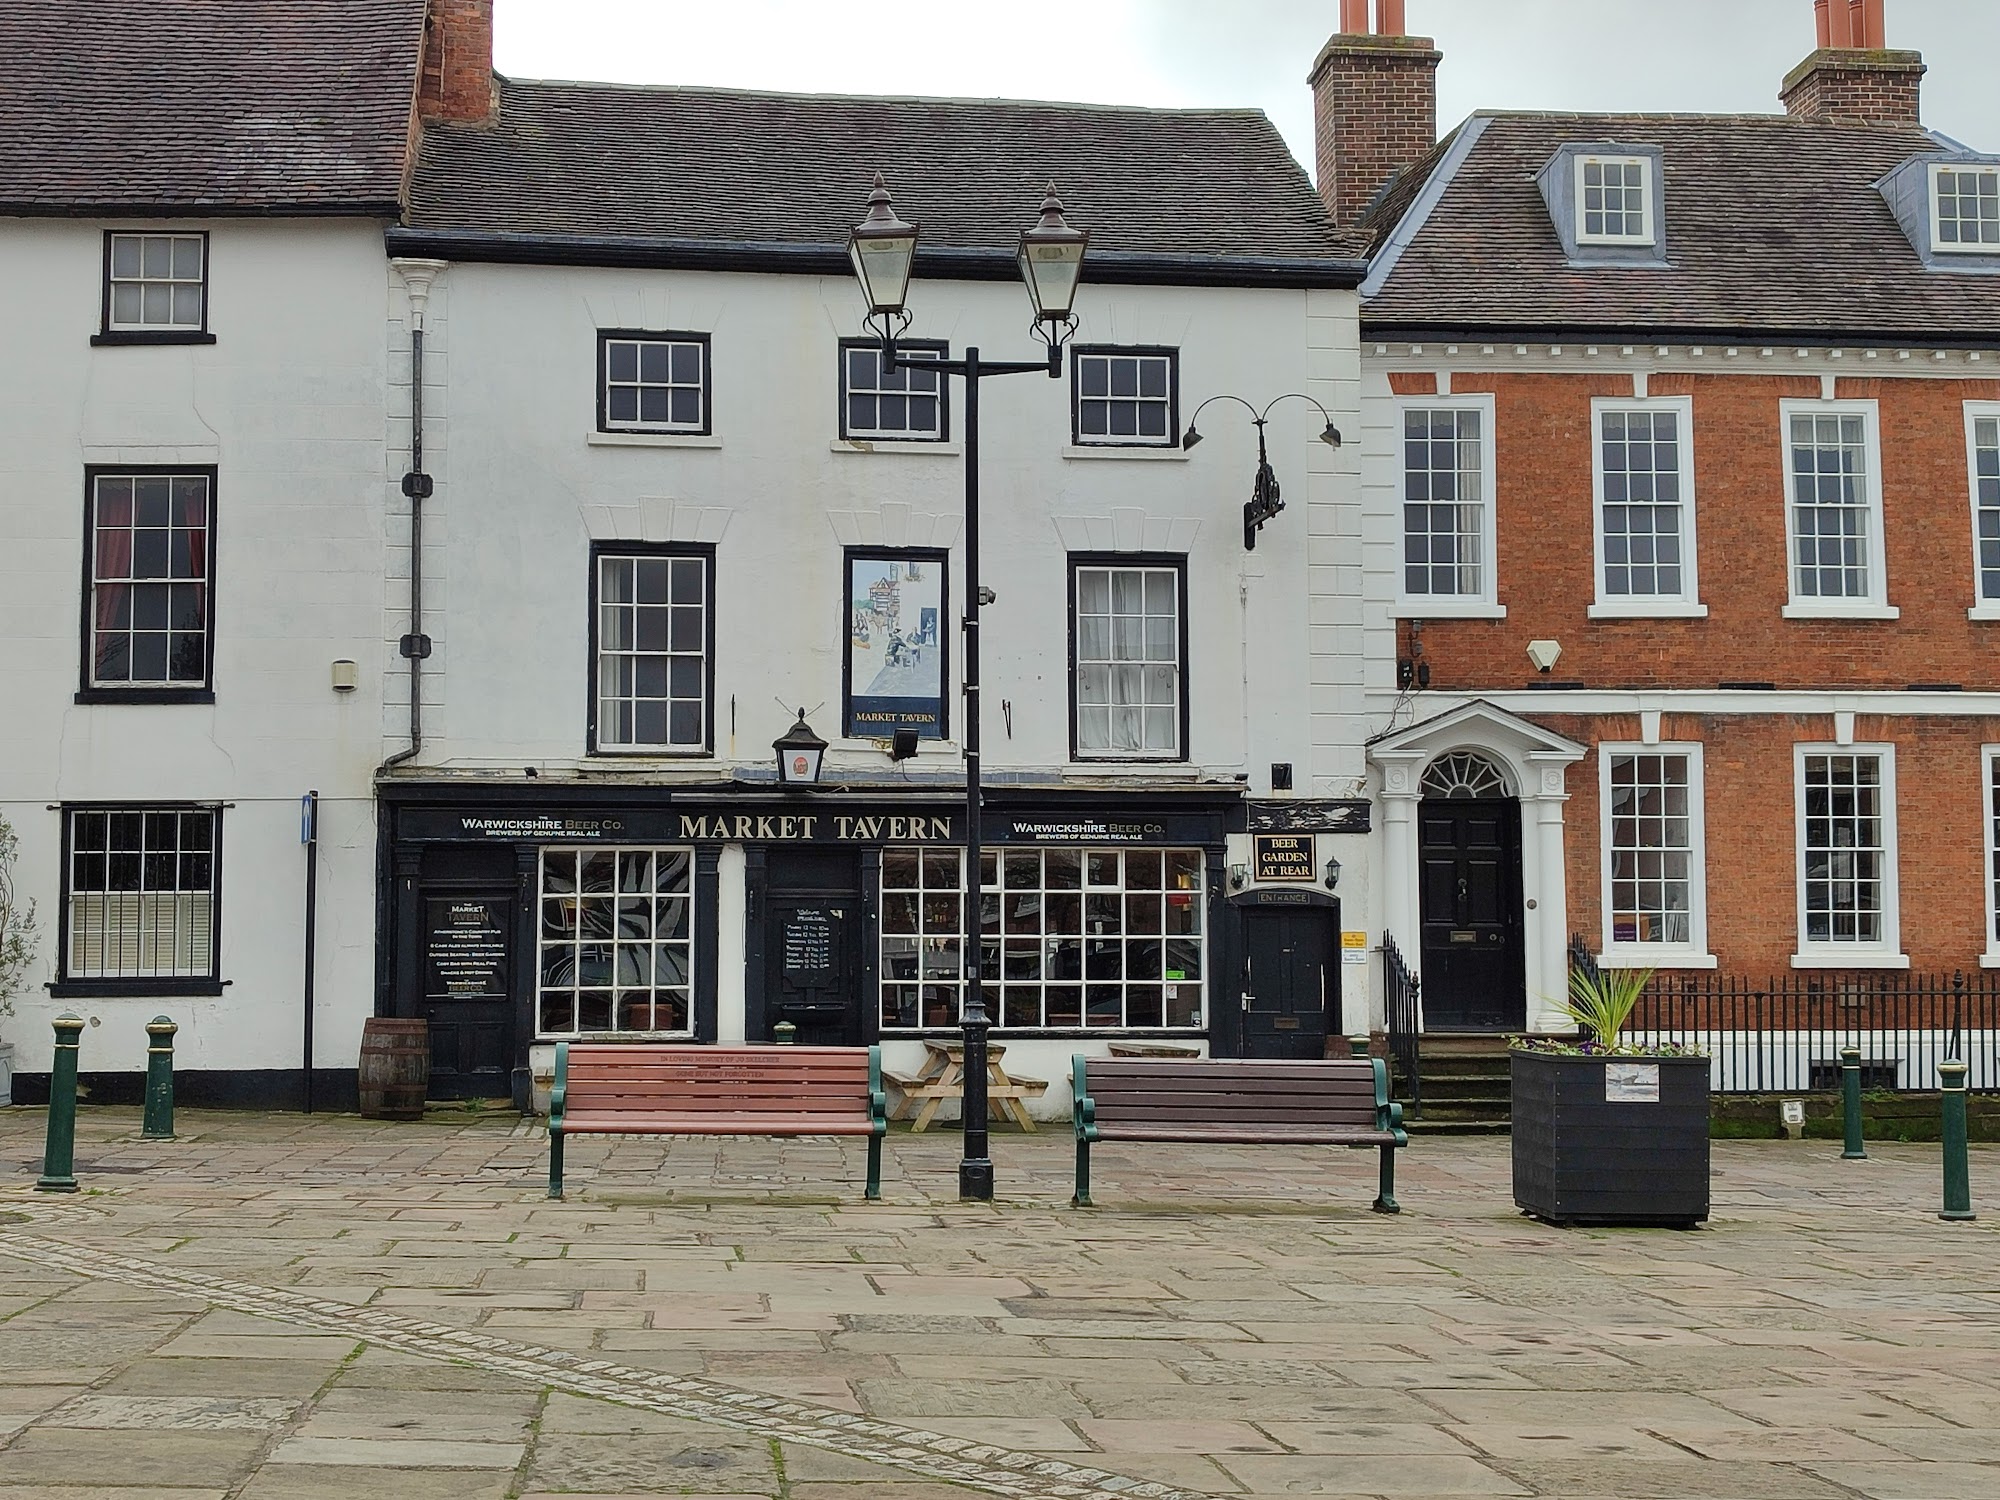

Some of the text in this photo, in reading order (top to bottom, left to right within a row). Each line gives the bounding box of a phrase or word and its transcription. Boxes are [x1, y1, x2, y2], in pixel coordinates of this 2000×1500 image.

[856, 712, 936, 723] MARKET TAVERN
[461, 818, 562, 829] WARWICKSHIRE
[565, 819, 599, 829] BEER
[679, 815, 952, 840] MARKET TAVERN
[1013, 822, 1106, 833] WARWICKSHIRE
[1109, 823, 1141, 833] BEER
[1271, 838, 1298, 849] BEER
[1262, 852, 1308, 862] GARDEN
[1262, 866, 1310, 875] AT REAR
[1260, 893, 1307, 902] ENTRANCE
[446, 912, 489, 921] TAVERN
